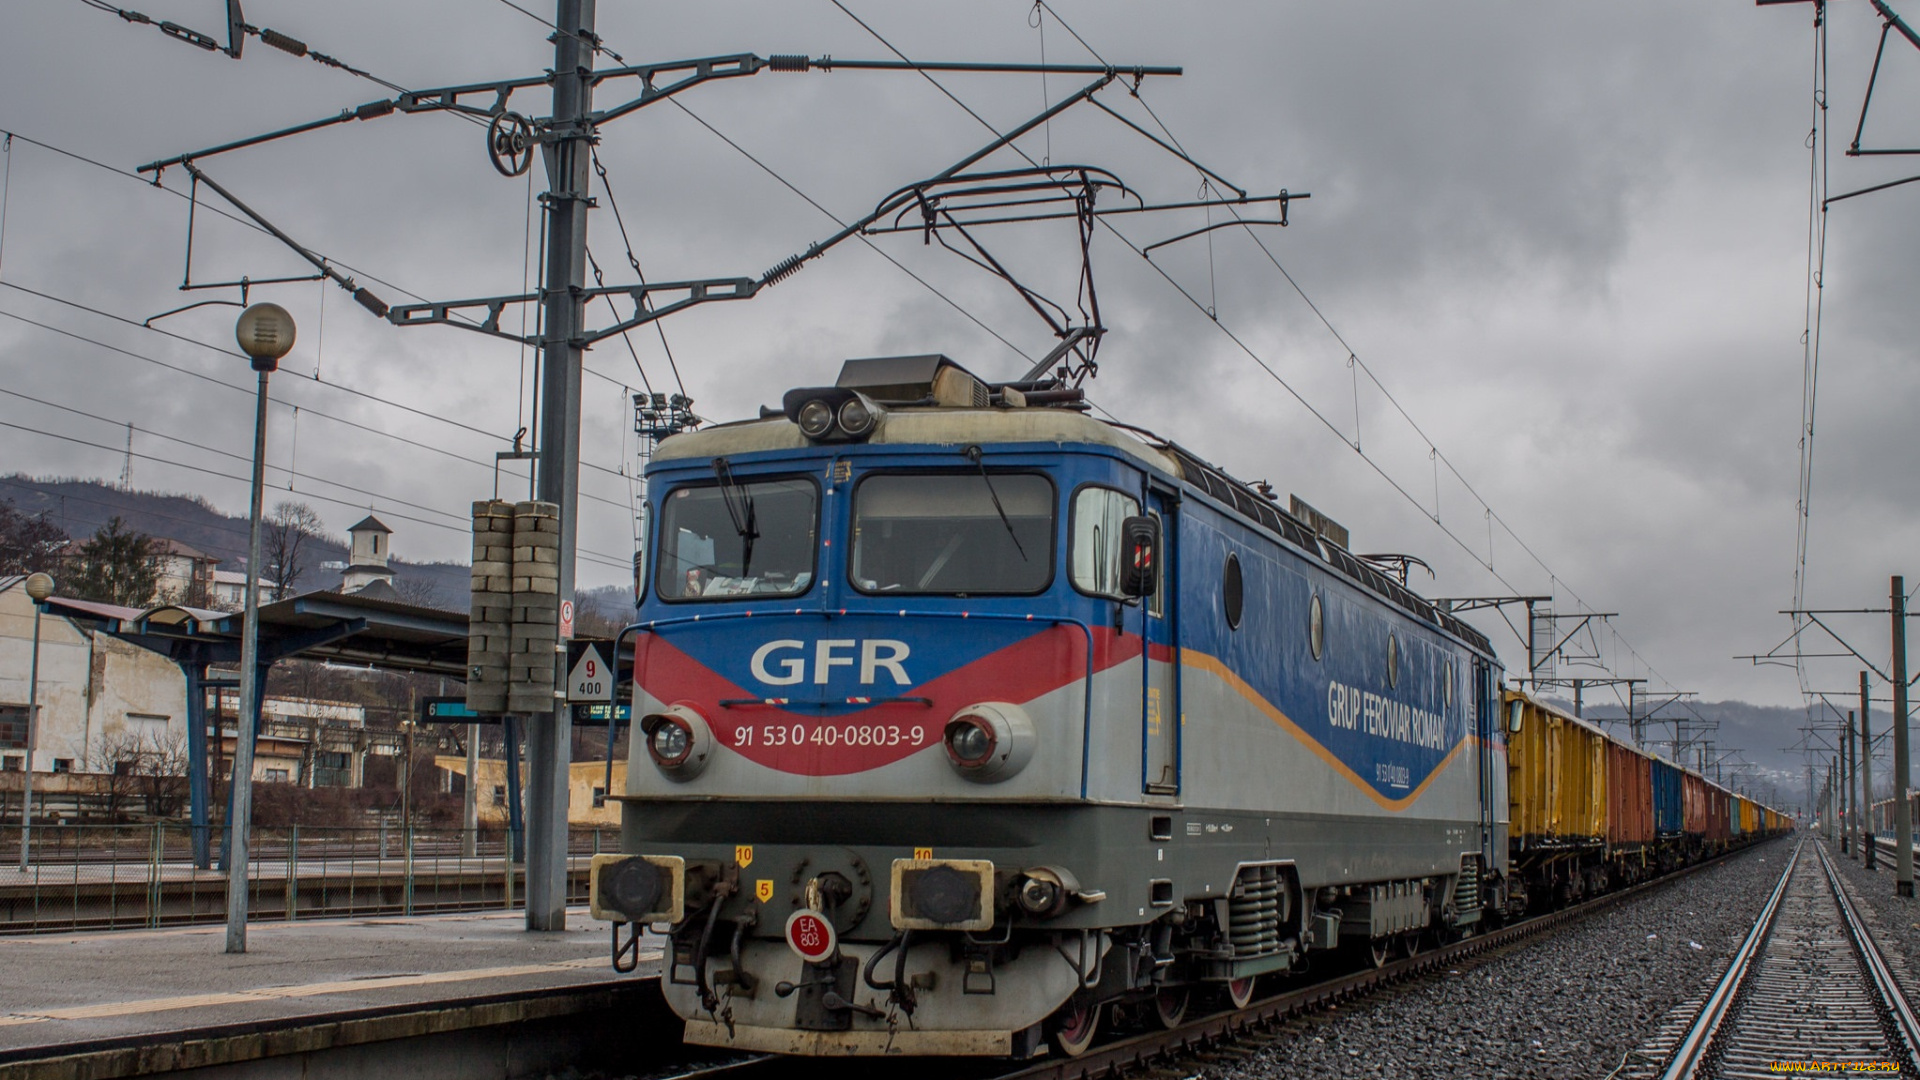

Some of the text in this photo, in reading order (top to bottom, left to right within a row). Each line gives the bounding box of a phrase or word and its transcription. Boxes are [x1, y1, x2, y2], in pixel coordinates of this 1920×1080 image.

[586, 660, 596, 678] 9
[750, 639, 912, 686] GFR
[579, 682, 602, 695] 400
[428, 702, 436, 716] 6
[1328, 680, 1445, 751] GRUP FEROVIAR ROMAN
[734, 724, 925, 747] 91 53 0 40-0803-9
[736, 847, 752, 861] 10
[760, 883, 769, 897] 5
[800, 918, 818, 932] EA
[800, 932, 820, 947] 803
